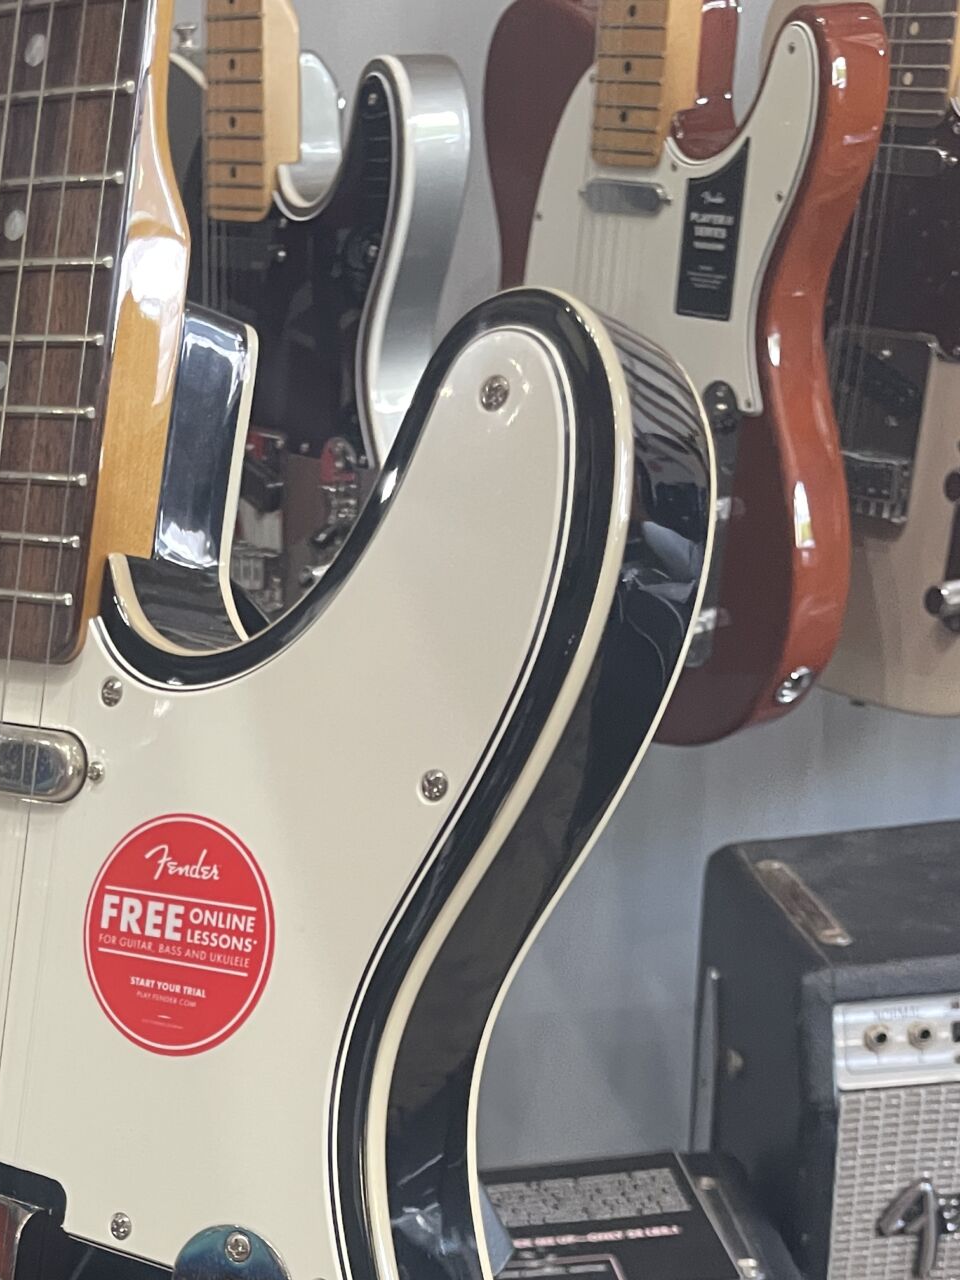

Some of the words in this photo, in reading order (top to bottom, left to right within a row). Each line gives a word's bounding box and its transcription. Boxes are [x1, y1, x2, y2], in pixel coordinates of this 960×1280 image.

[144, 844, 220, 880] Fender
[100, 894, 185, 942] FREE
[189, 908, 256, 933] ONLINE
[98, 933, 117, 945] FOR
[158, 943, 182, 957] BASS
[184, 948, 207, 961] AND
[209, 953, 250, 968] UKULELE
[130, 976, 155, 988] START
[156, 980, 181, 993] YOUR
[182, 985, 207, 999] TRIAL
